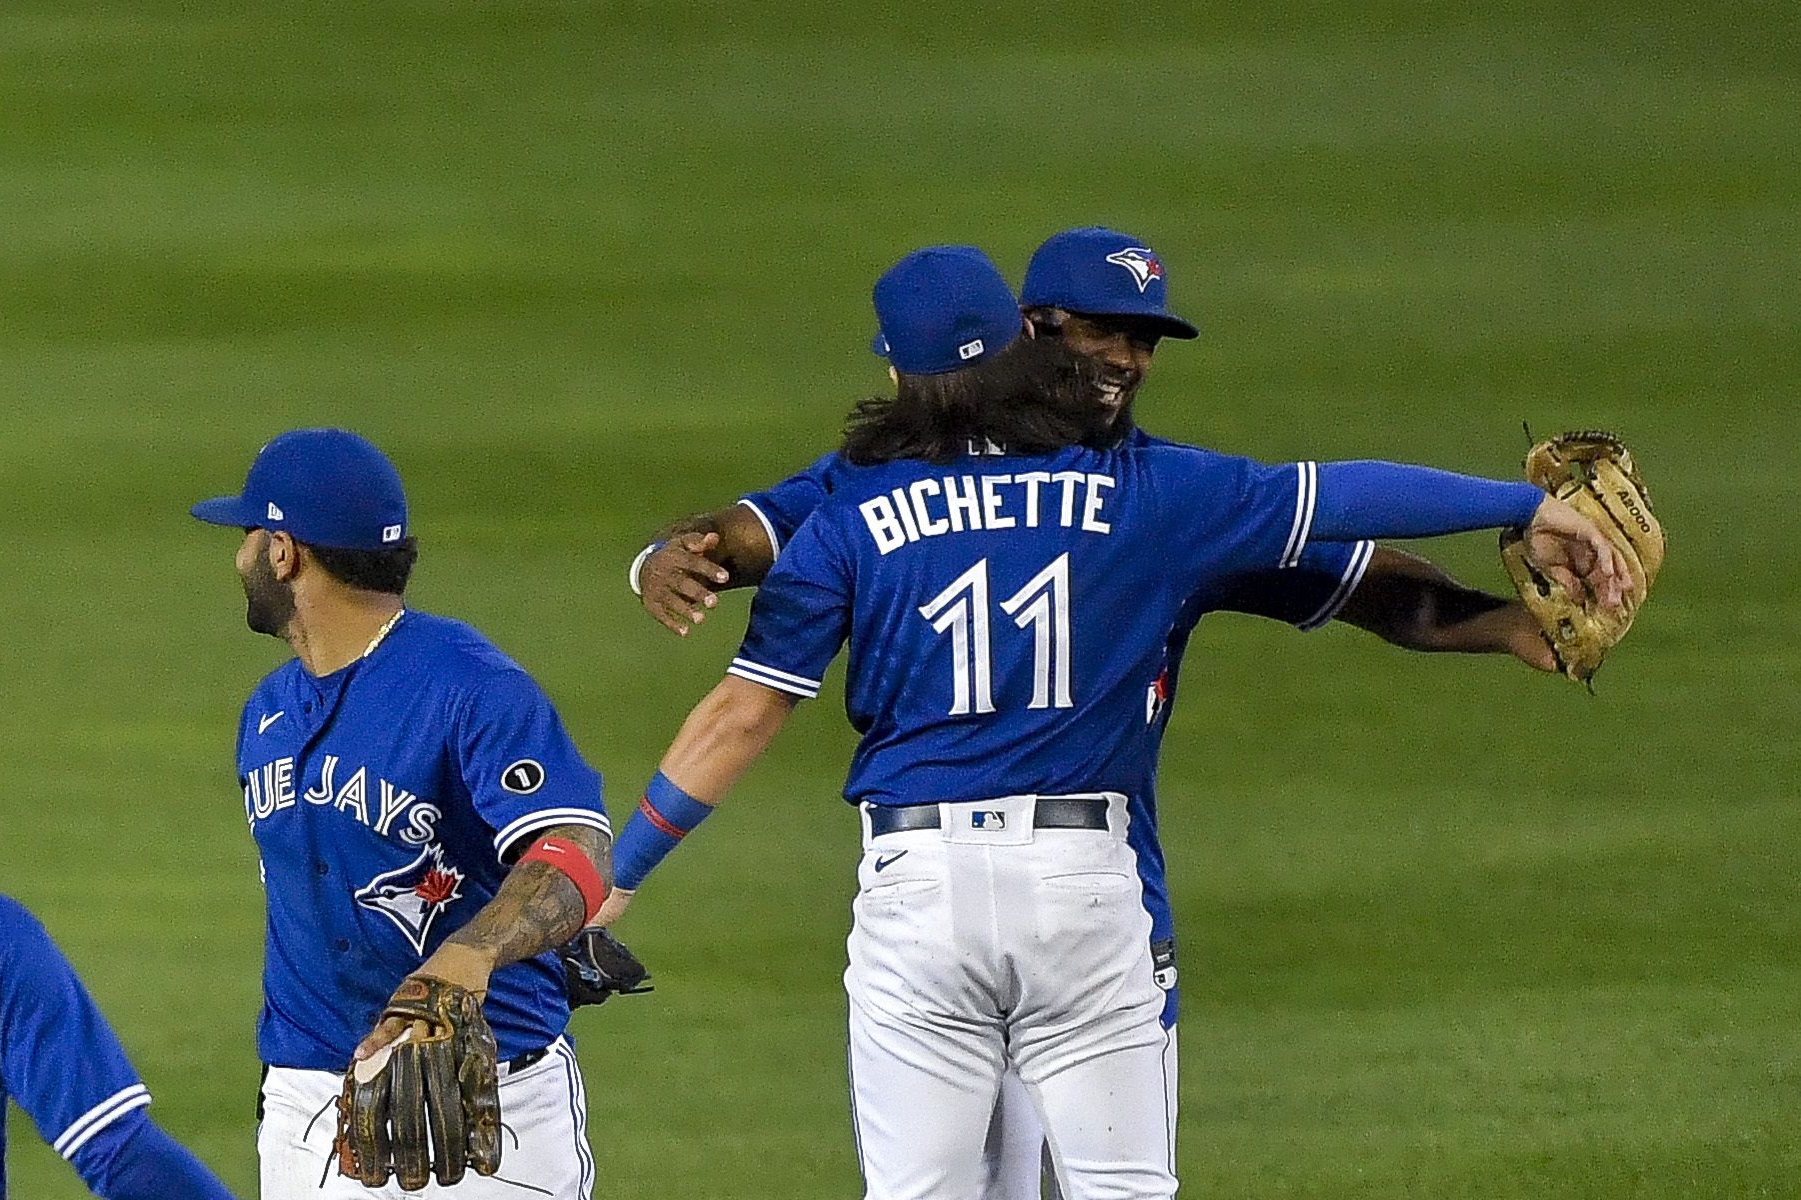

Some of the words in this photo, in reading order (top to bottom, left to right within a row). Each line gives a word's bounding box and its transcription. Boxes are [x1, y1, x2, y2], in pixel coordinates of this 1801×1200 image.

[858, 471, 1116, 556] BICHETTE
[1616, 491, 1650, 533] A2000
[918, 551, 1074, 716] 11
[303, 755, 443, 845] JAYS
[514, 767, 531, 788] 1
